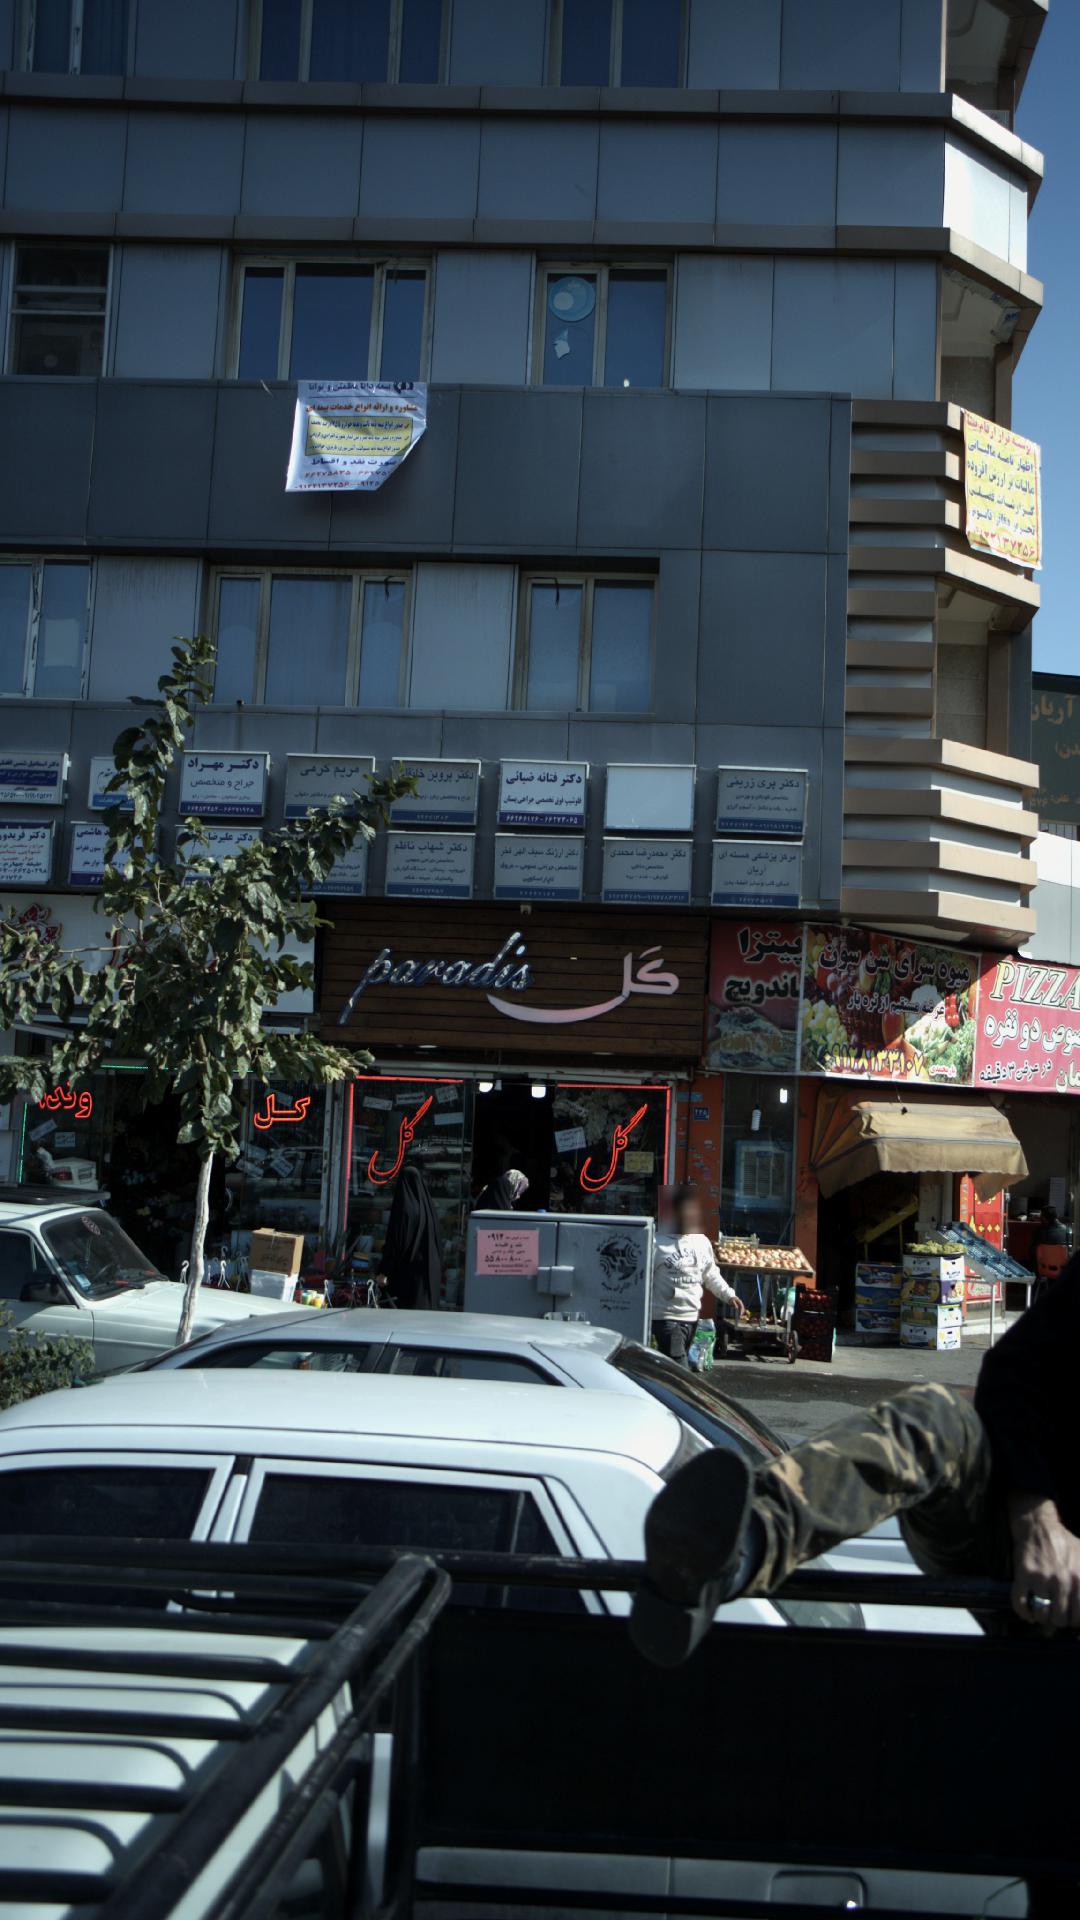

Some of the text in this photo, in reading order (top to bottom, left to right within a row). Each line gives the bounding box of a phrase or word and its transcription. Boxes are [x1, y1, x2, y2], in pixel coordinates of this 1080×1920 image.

[187, 757, 259, 773] دکتر مهراد
[455, 769, 475, 783] دکتر
[537, 772, 559, 784] فتانه
[559, 773, 582, 787] دکتر
[190, 779, 226, 788] متخصص
[234, 779, 255, 791] جراح
[779, 778, 800, 790] دکتر
[28, 830, 46, 841] دکتر
[208, 832, 254, 844] دکتر علیرضا
[447, 842, 468, 855] دکتر
[563, 849, 579, 858] دکتر
[669, 849, 687, 860] دکتر
[892, 949, 937, 983] سرای
[938, 957, 972, 990] میوه
[486, 945, 680, 1024] گل
[724, 972, 801, 1008] اندویچ
[989, 959, 1080, 1013] PIZZA
